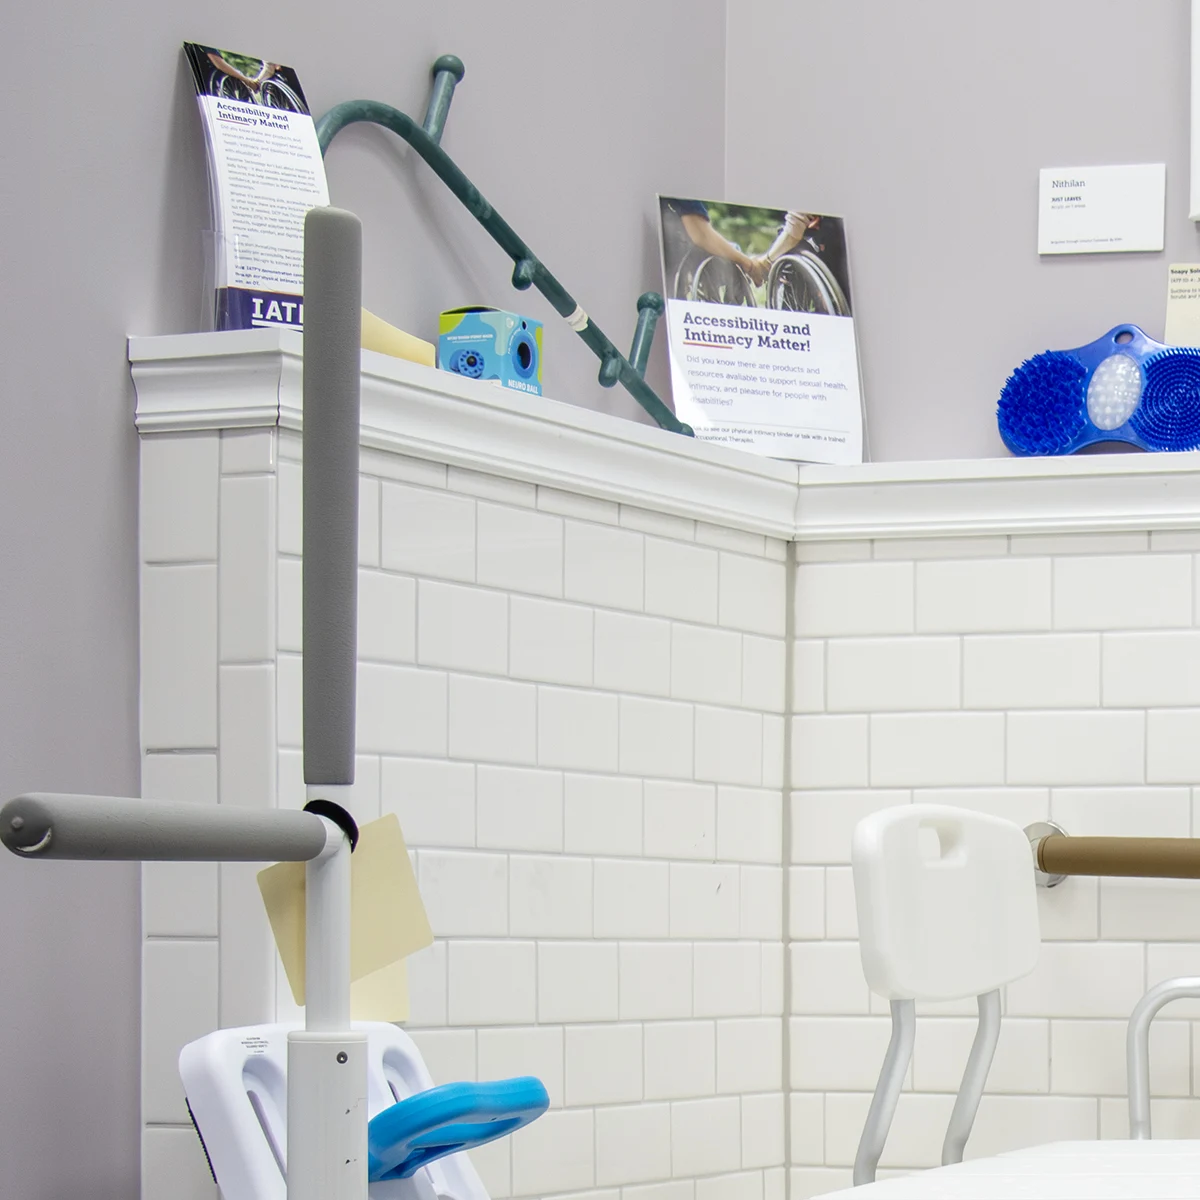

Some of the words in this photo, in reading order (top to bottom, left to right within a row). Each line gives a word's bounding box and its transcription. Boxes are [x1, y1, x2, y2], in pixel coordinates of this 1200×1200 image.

[217, 102, 270, 119] Accessibility
[218, 112, 257, 126] Intimacy
[259, 119, 290, 130] Matter!
[1052, 180, 1086, 188] Nithilan
[252, 298, 304, 324] IAT
[683, 312, 778, 335] Accessibility
[783, 324, 811, 335] and
[684, 329, 753, 349] Intimacy
[758, 335, 811, 351] Matter!
[717, 358, 735, 366] know
[738, 360, 756, 368] there
[773, 364, 804, 373] products
[508, 379, 526, 390] NEURO
[527, 384, 538, 394] BALL
[726, 373, 757, 382] available
[824, 381, 848, 390] health,
[689, 382, 721, 393] intimacy,
[740, 387, 770, 396] pleasure
[785, 392, 809, 400] people
